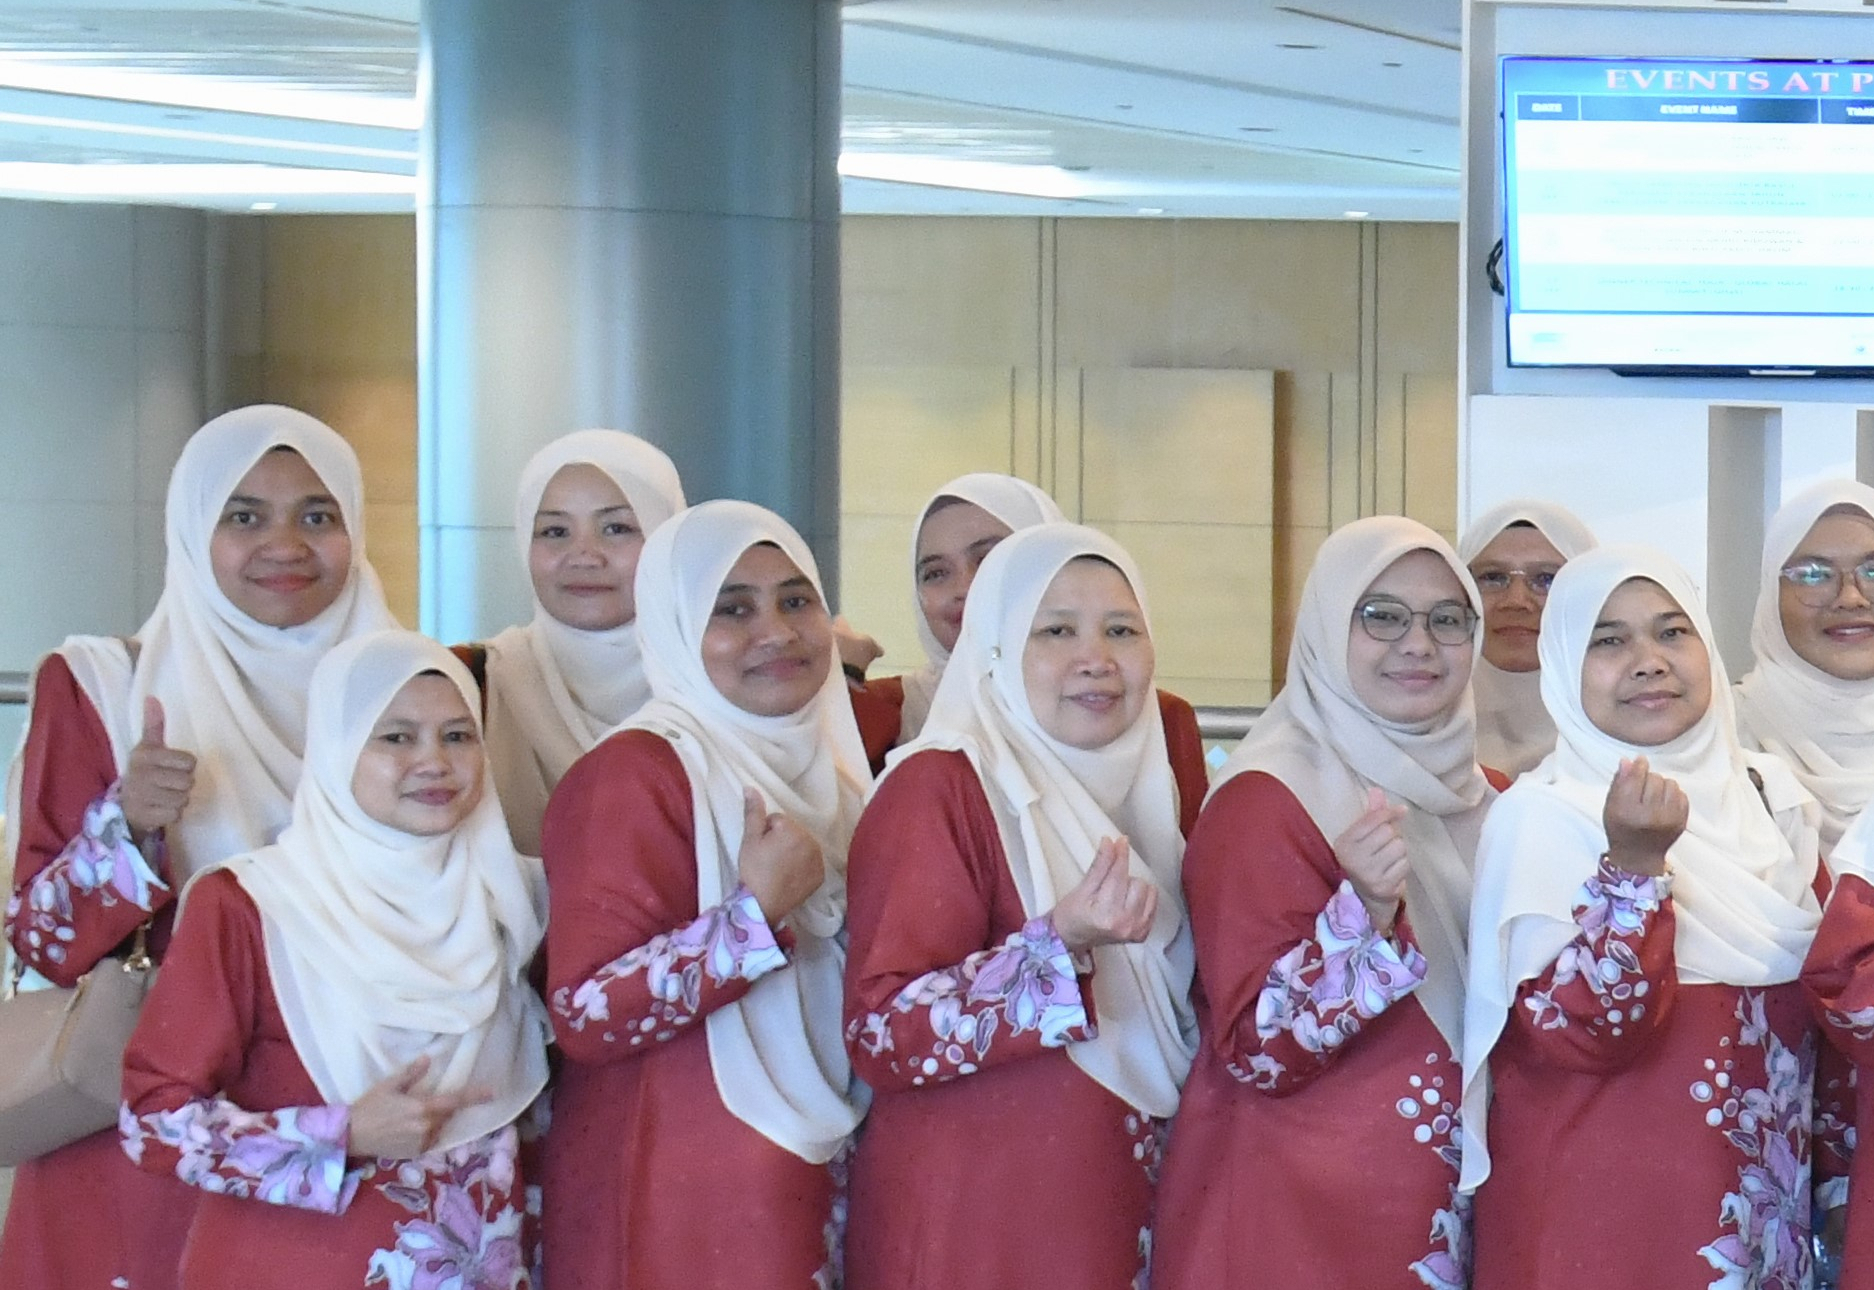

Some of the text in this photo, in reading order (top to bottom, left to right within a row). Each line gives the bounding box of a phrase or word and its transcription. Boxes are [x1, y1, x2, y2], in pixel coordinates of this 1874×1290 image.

[1606, 69, 1770, 91] EVENTS
[1782, 72, 1839, 92] AT
[1659, 104, 1699, 114] EVENT
